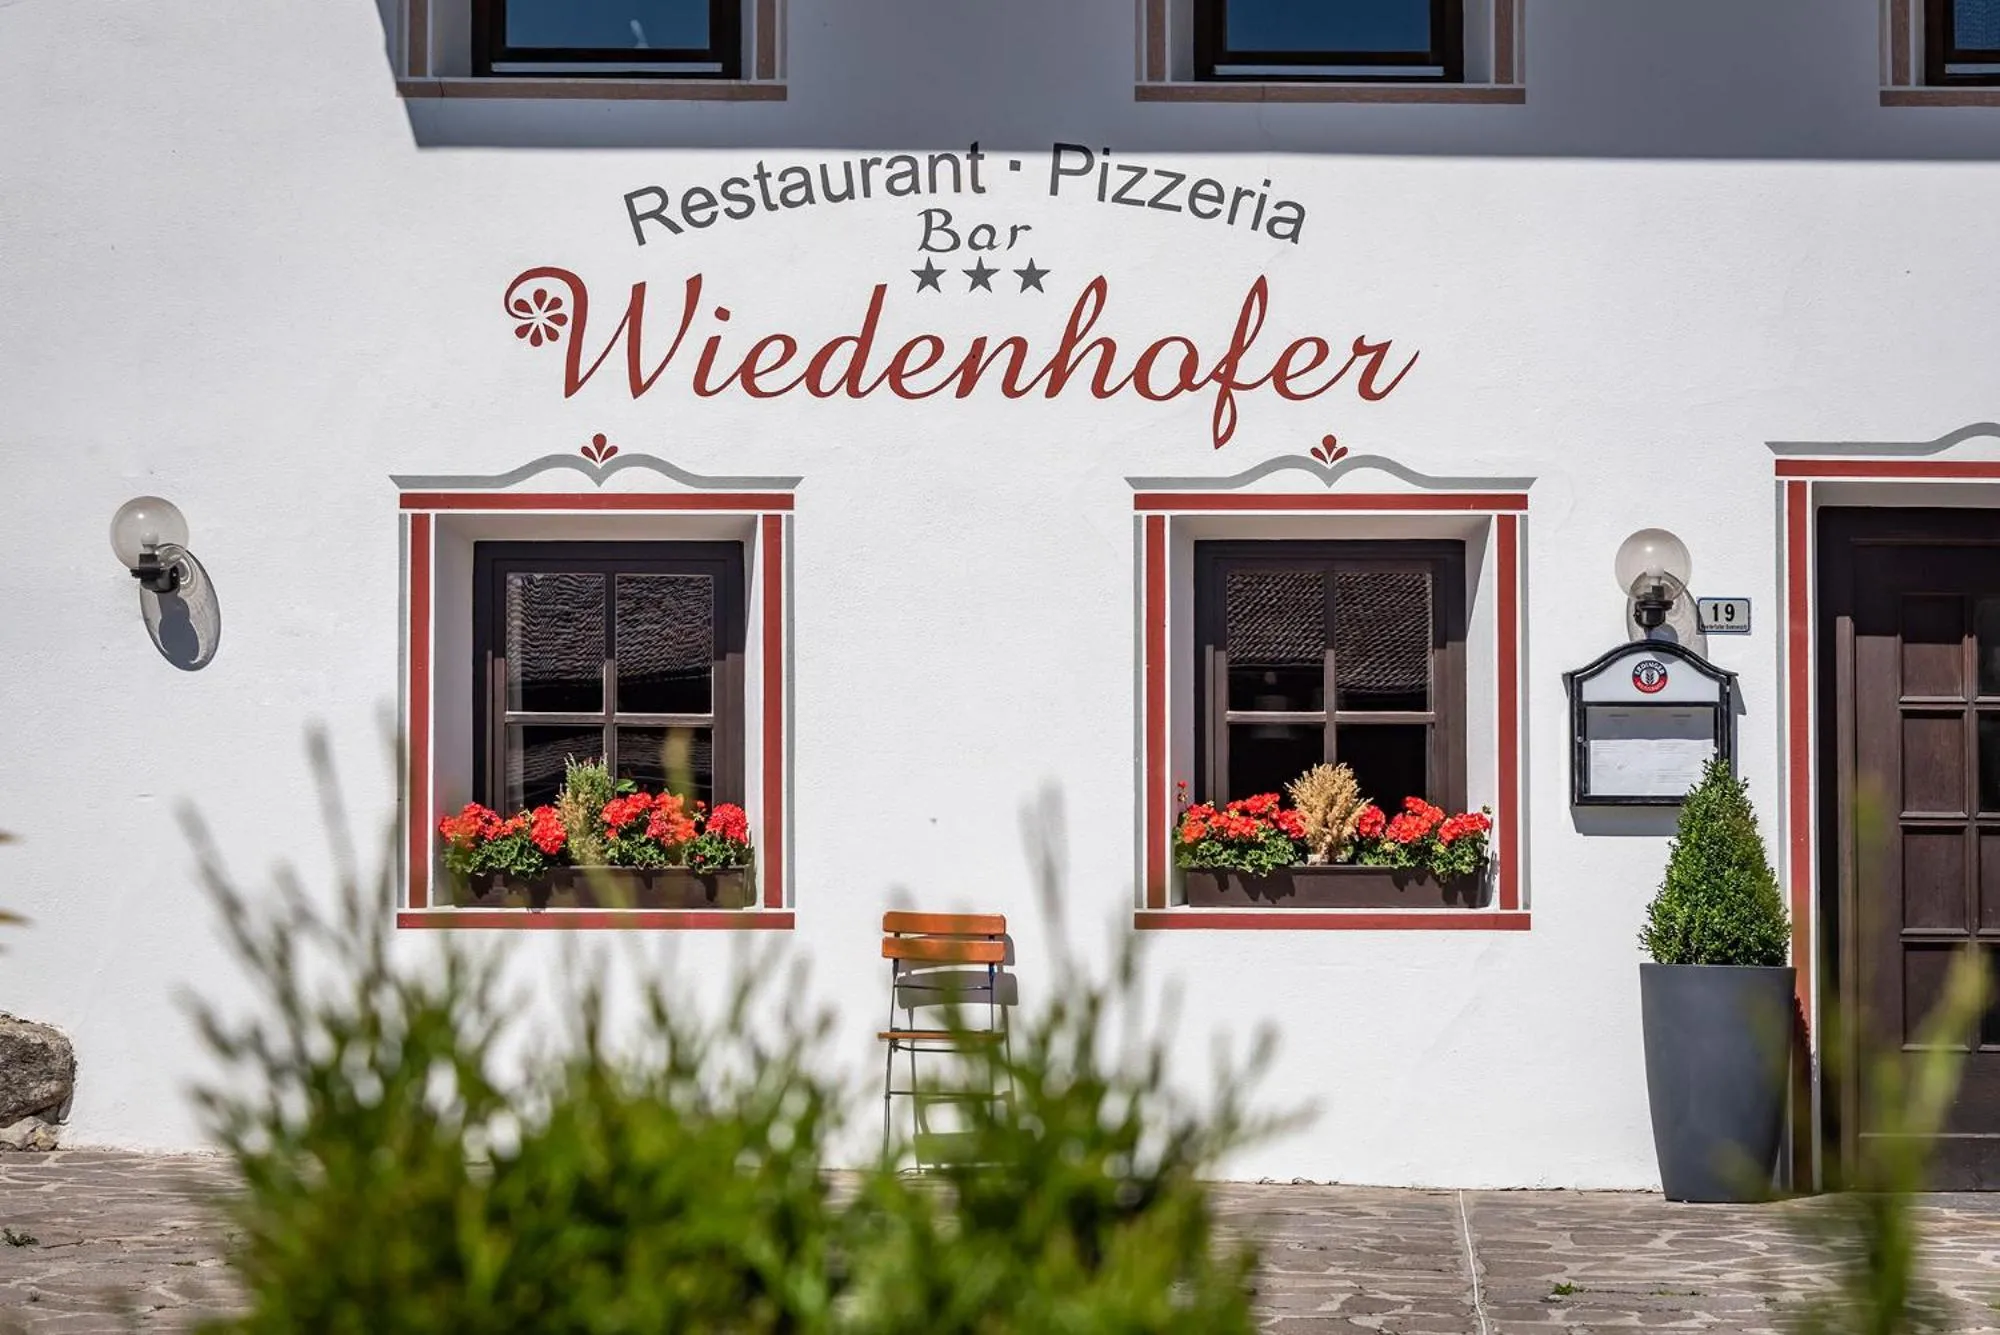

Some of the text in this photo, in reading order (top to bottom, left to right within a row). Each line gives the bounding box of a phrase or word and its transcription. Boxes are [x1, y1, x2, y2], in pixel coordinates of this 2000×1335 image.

[623, 141, 985, 246] Restaurant
[1048, 142, 1306, 245] Pizzeria
[916, 208, 1032, 252] Bar
[504, 266, 1420, 449] Wiedenhofer
[1712, 602, 1736, 622] 19
